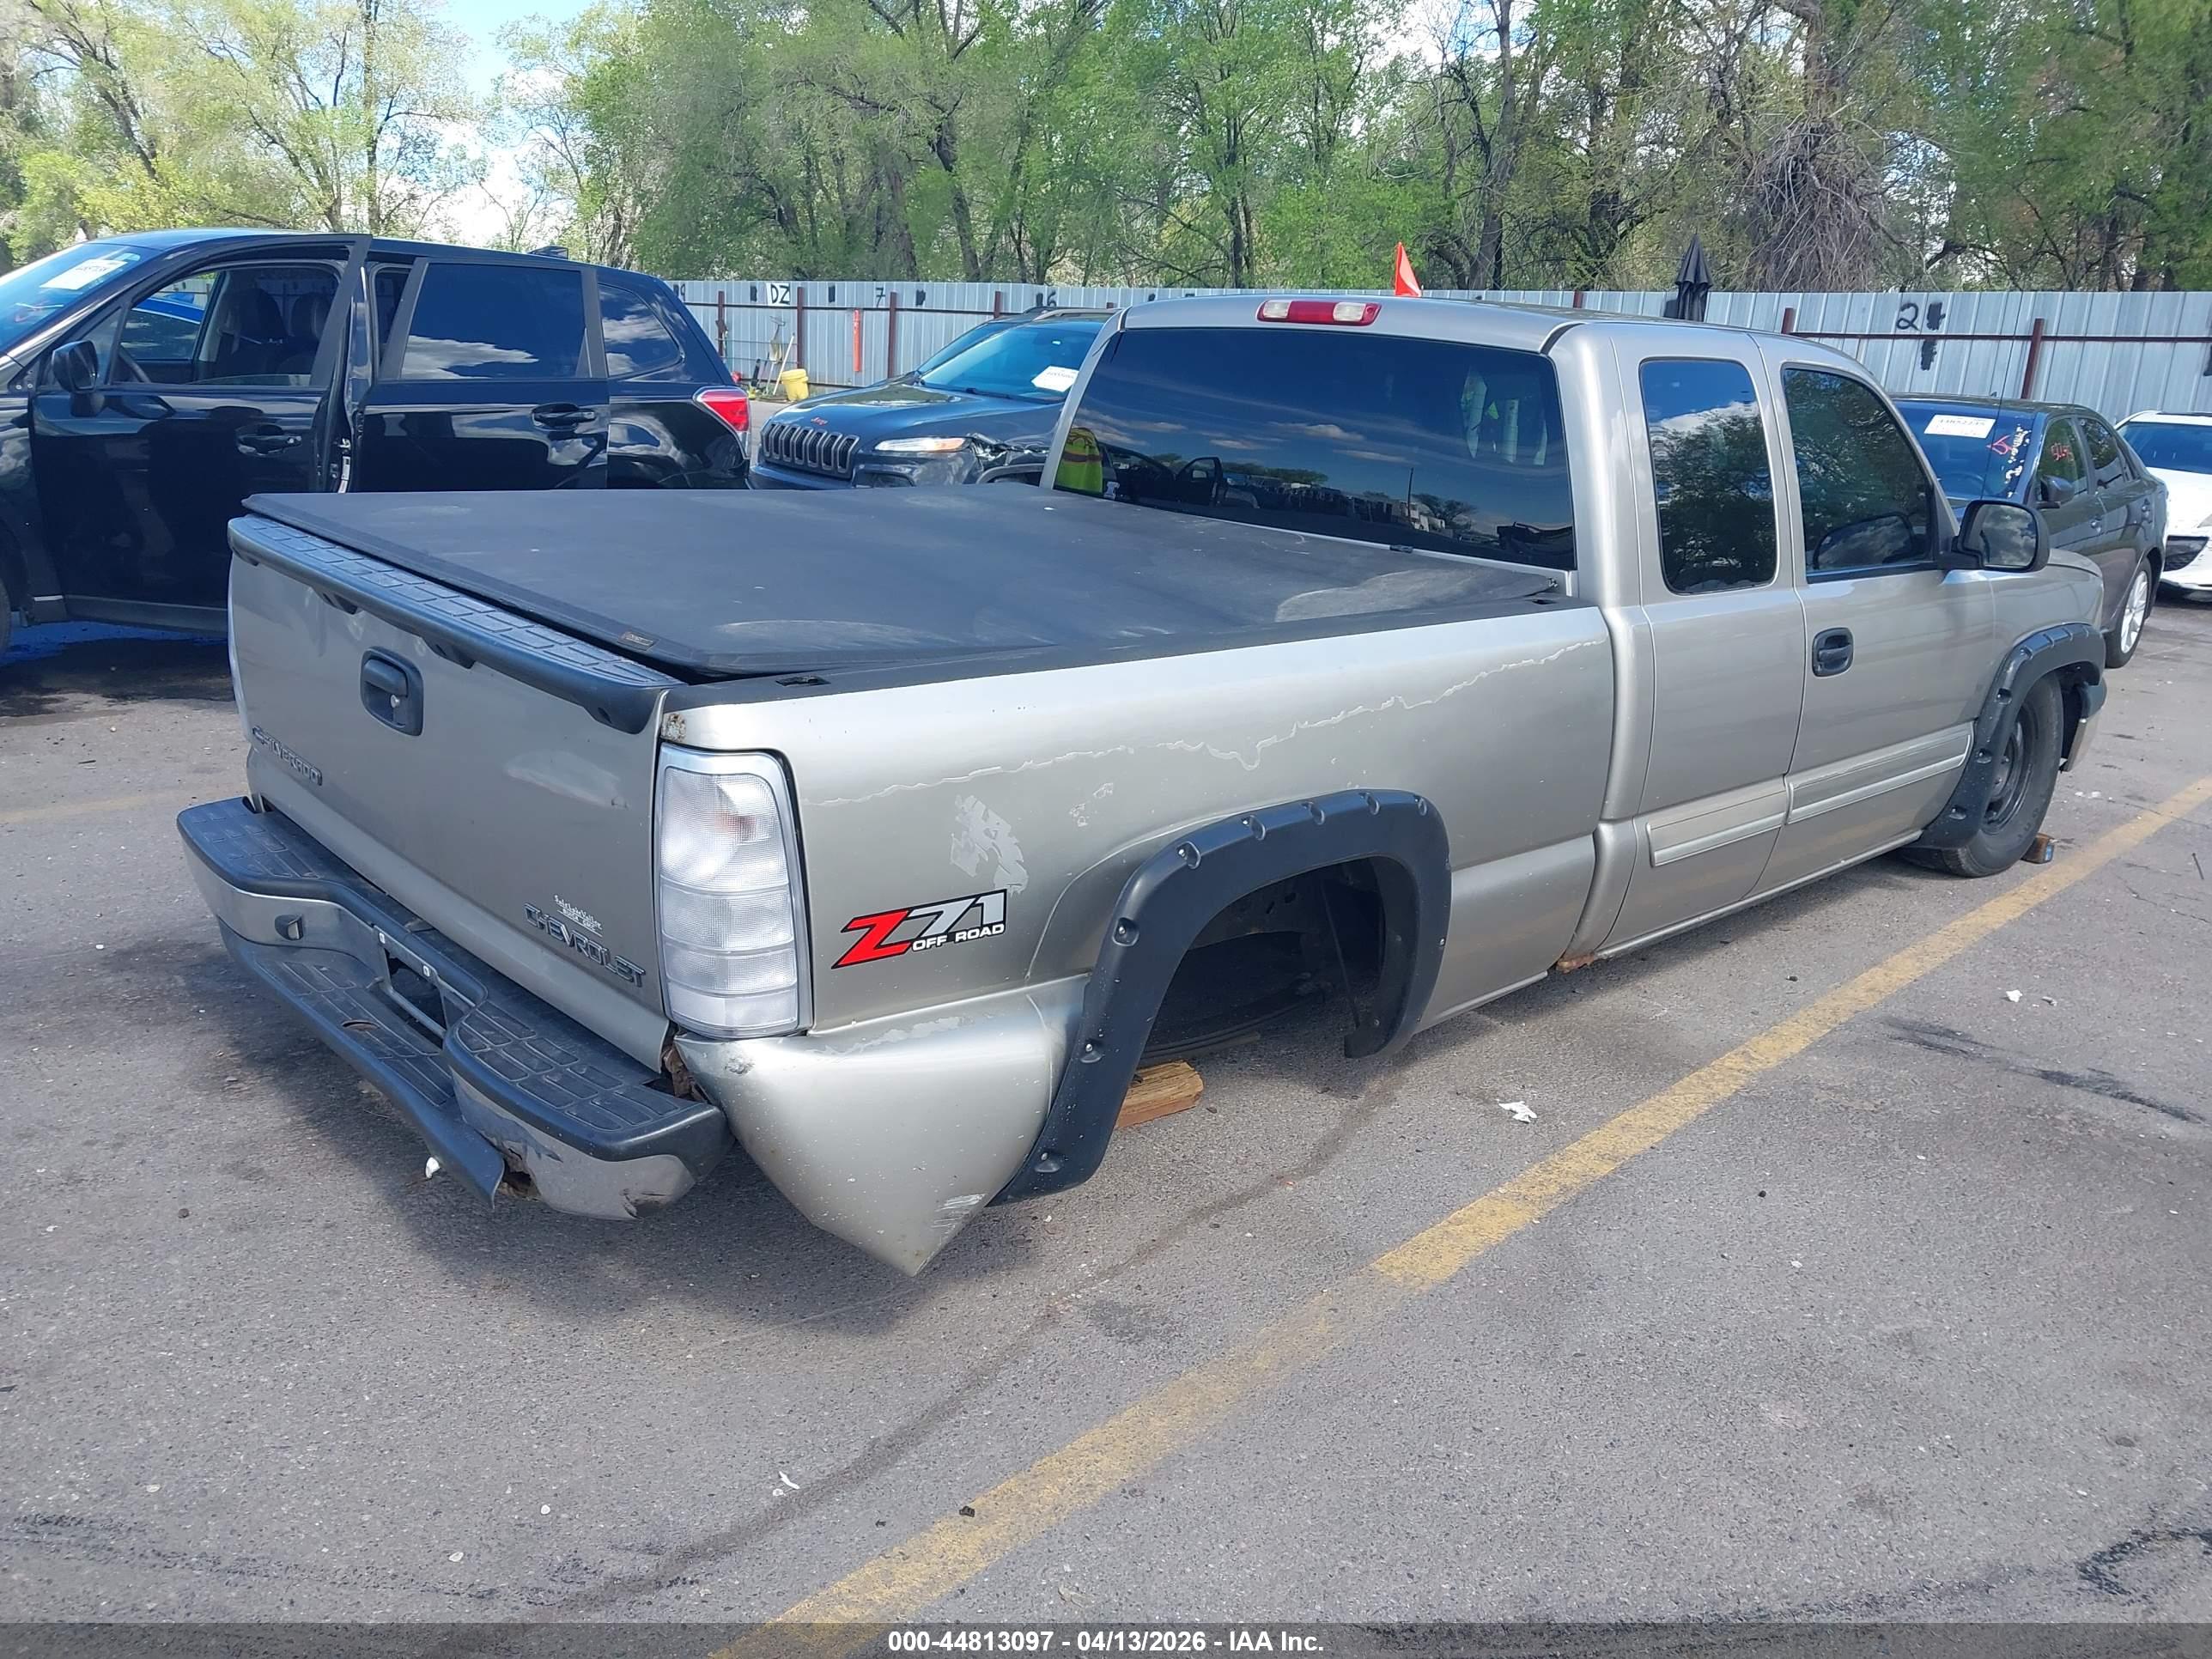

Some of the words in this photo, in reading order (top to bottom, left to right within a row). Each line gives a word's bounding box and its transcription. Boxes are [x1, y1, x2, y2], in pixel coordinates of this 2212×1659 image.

[770, 284, 791, 305] DZ
[875, 287, 886, 307] 7
[1896, 303, 1920, 331] 2
[252, 726, 323, 787] SILVERADO
[830, 889, 1007, 969] Z71
[911, 935, 948, 952] OFF
[954, 922, 1006, 944] ROAD
[522, 902, 646, 987] CHEVROLET
